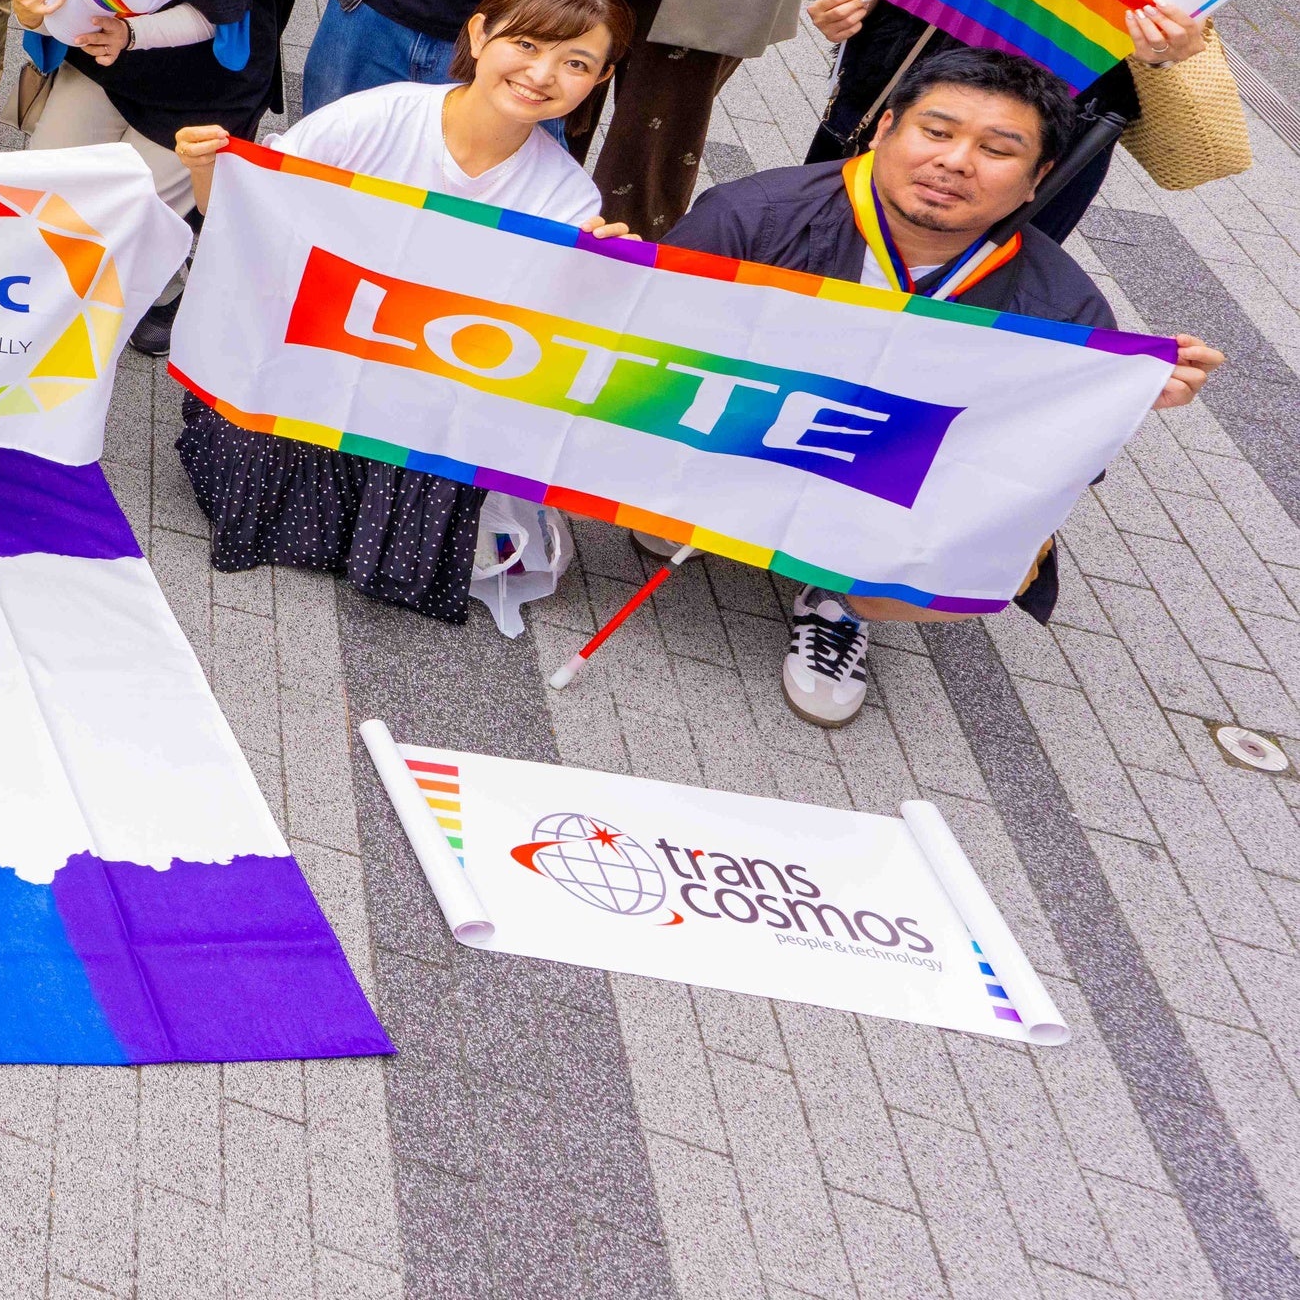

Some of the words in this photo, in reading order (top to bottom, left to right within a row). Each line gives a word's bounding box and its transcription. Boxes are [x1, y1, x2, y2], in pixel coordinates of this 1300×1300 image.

[343, 277, 890, 464] LOTTE
[654, 836, 821, 900] trans
[679, 880, 936, 957] cosmos
[775, 932, 833, 950] people
[848, 943, 943, 973] technology
